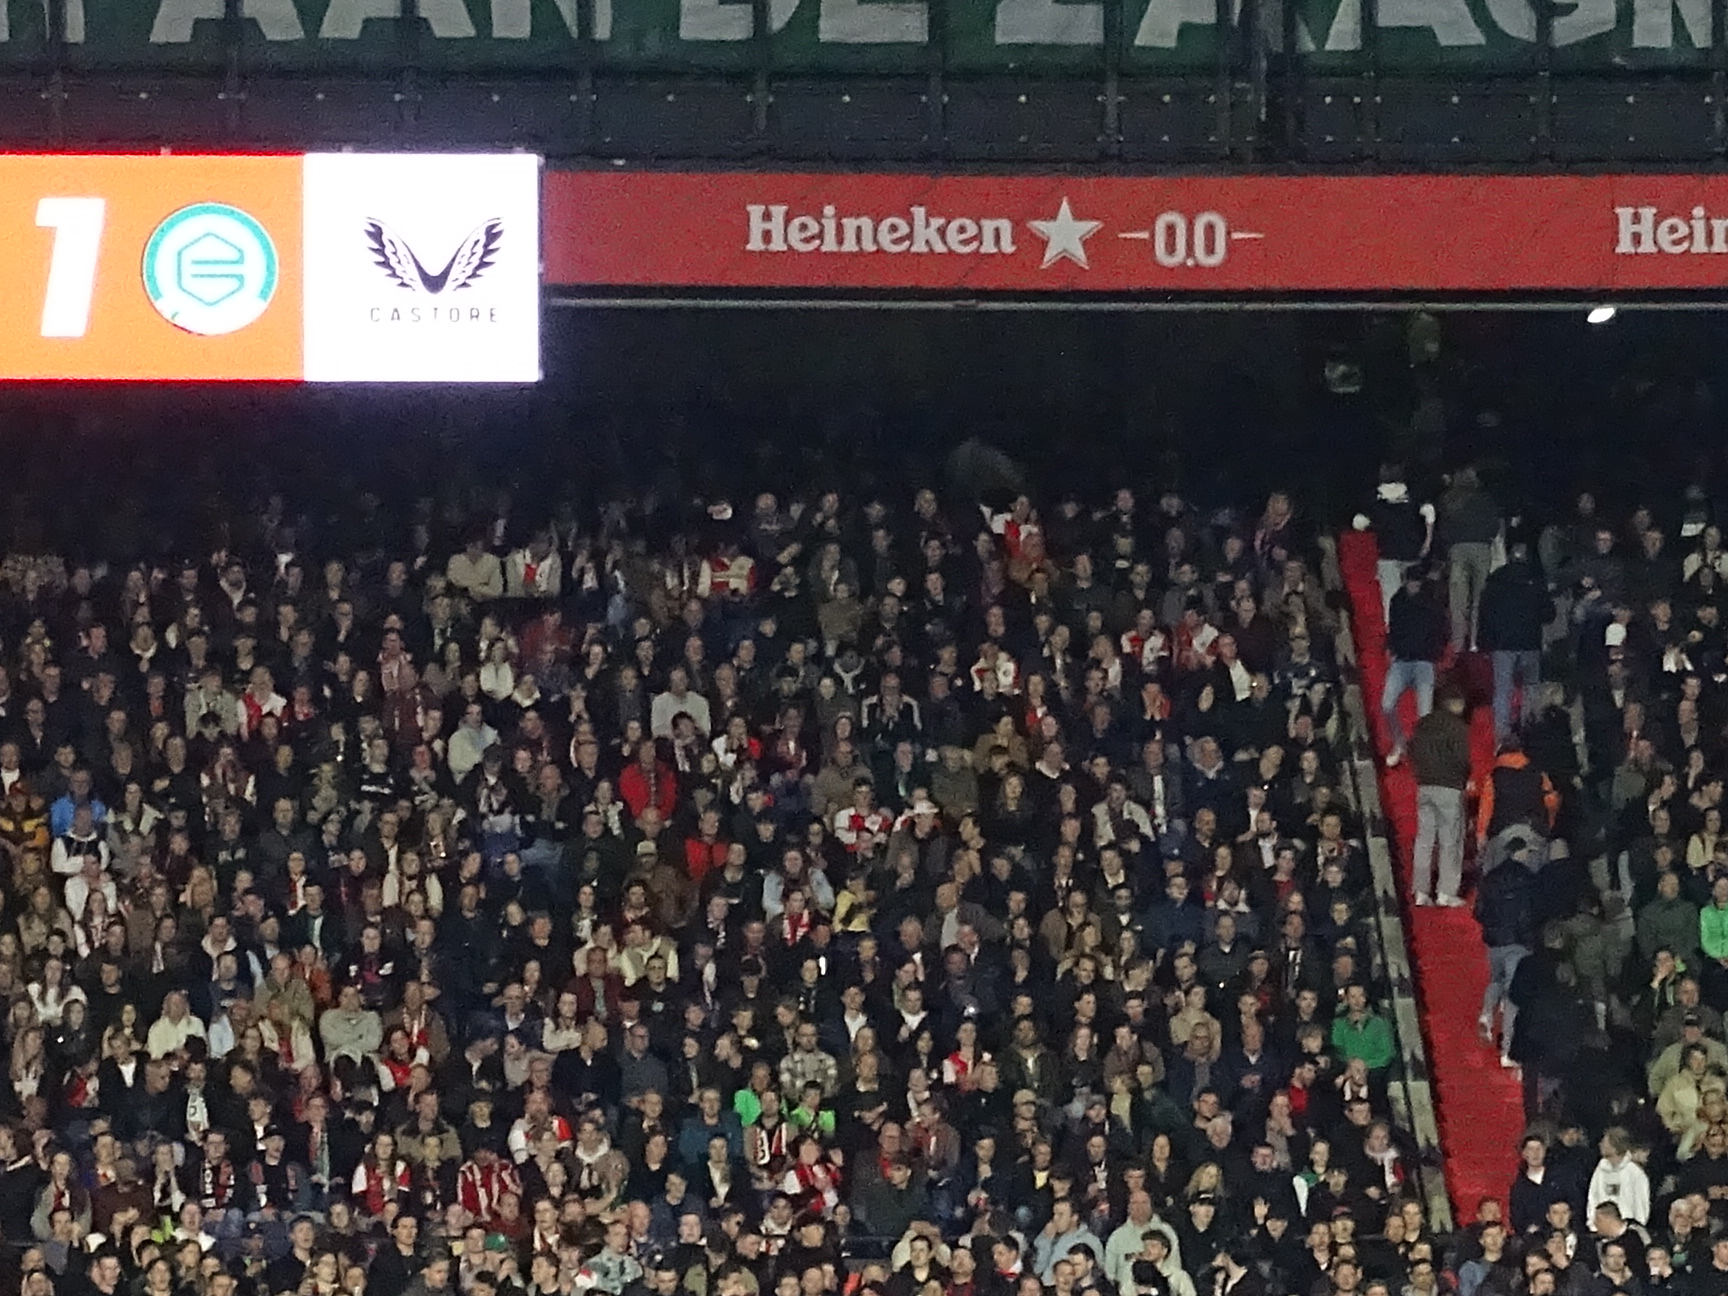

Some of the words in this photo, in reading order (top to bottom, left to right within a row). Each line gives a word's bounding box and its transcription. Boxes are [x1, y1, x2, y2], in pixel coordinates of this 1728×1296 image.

[745, 204, 1016, 254] Heineken
[34, 197, 106, 337] 1
[369, 306, 499, 324] CASTORE
